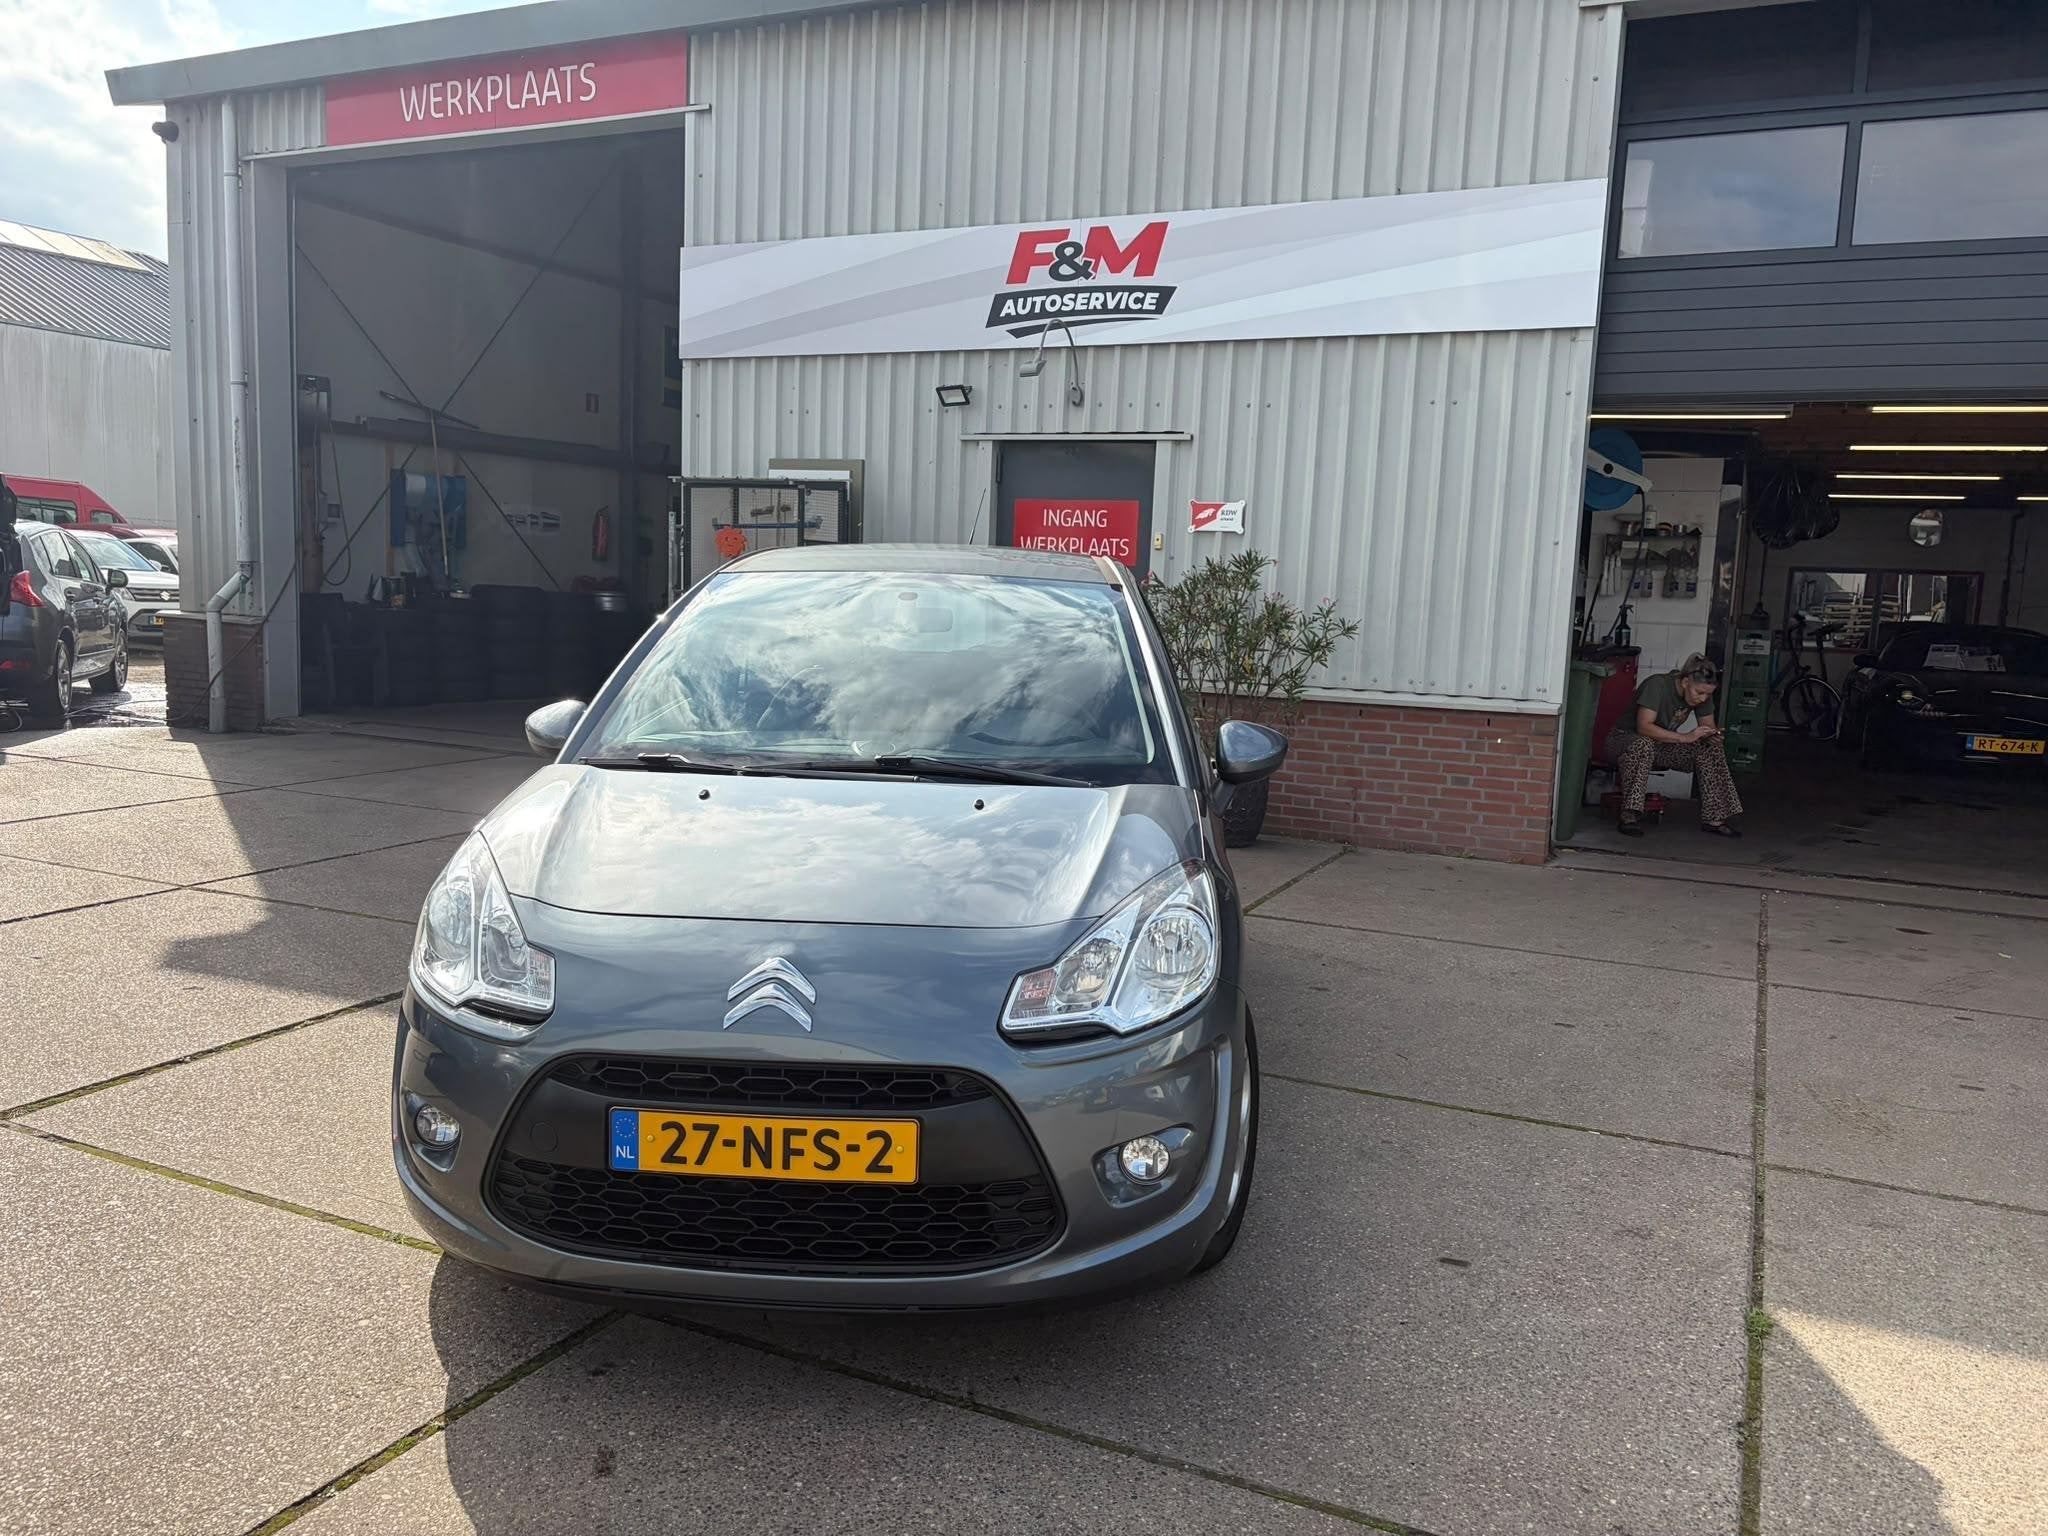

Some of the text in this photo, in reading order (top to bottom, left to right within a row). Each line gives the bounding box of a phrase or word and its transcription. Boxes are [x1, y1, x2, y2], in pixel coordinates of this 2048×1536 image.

[399, 62, 598, 122] WERKPLAATS
[1005, 221, 1170, 285] F&M
[999, 291, 1160, 318] AUTOSERVICE
[1043, 508, 1108, 528] INGANG
[1020, 535, 1130, 557] WERKPLAATS
[1977, 738, 2039, 752] RT-674-K
[615, 1120, 894, 1174] NL 27-NFS-2
